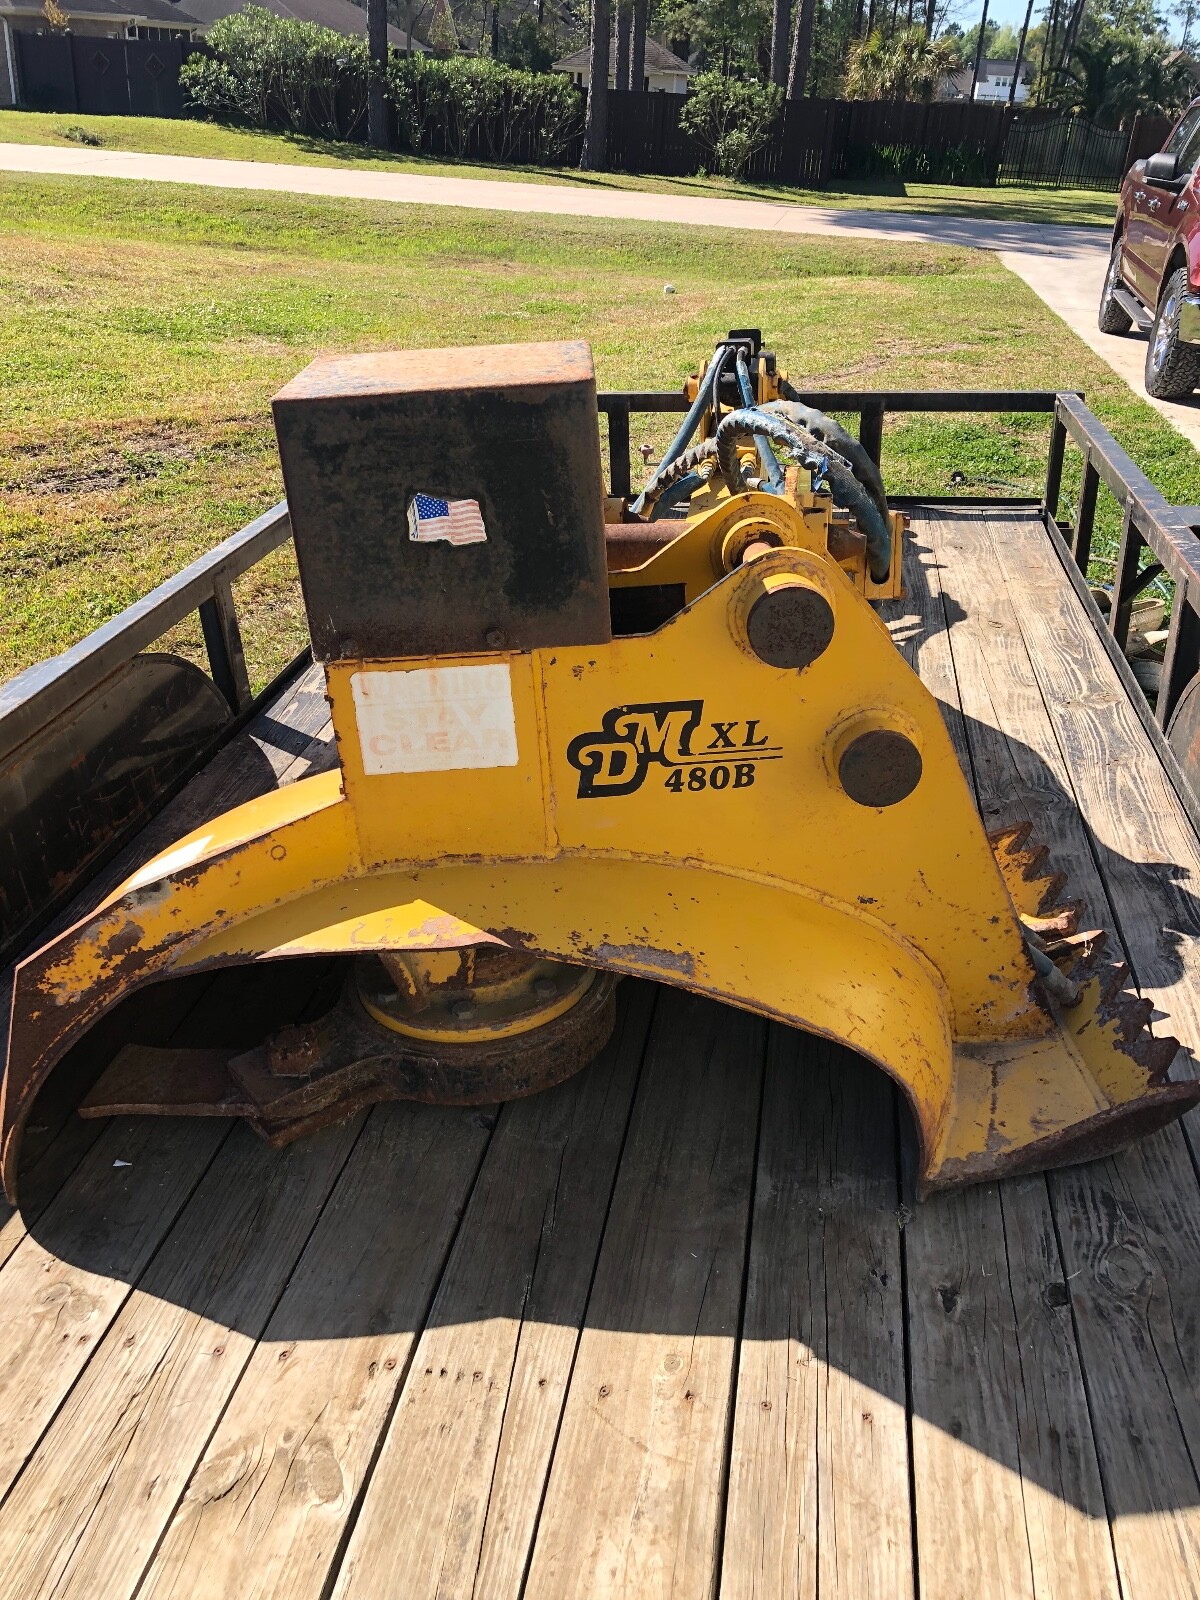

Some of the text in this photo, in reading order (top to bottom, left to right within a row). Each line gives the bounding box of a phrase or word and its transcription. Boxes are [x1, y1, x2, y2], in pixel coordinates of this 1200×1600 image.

[383, 703, 488, 731] STAY
[369, 728, 510, 756] CLEAR
[707, 720, 769, 749] XL
[664, 764, 756, 793] 480B
